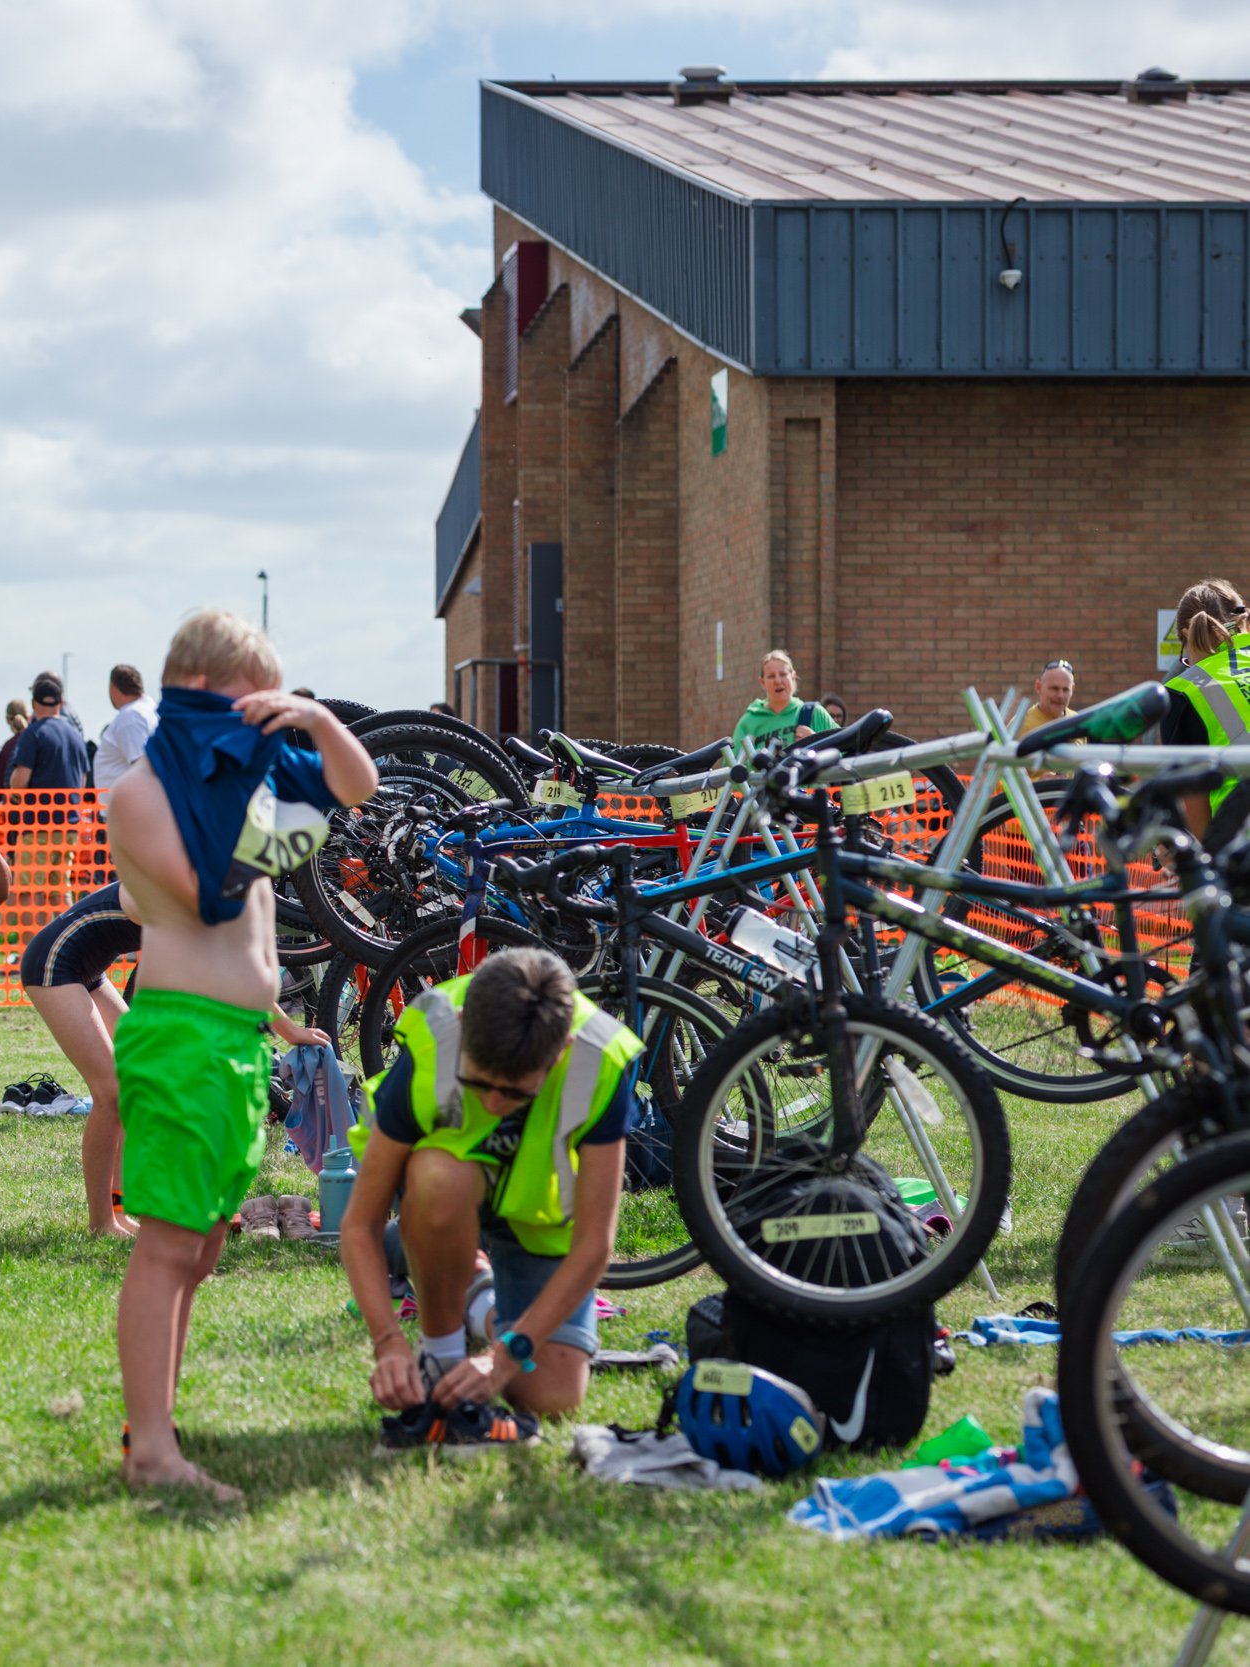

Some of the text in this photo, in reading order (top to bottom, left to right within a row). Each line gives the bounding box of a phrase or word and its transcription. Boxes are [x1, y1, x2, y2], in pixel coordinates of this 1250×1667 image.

[456, 775, 473, 790] 222
[547, 786, 561, 799] 219
[879, 784, 906, 802] 213
[705, 944, 745, 975] TEAM
[748, 968, 780, 993] sky
